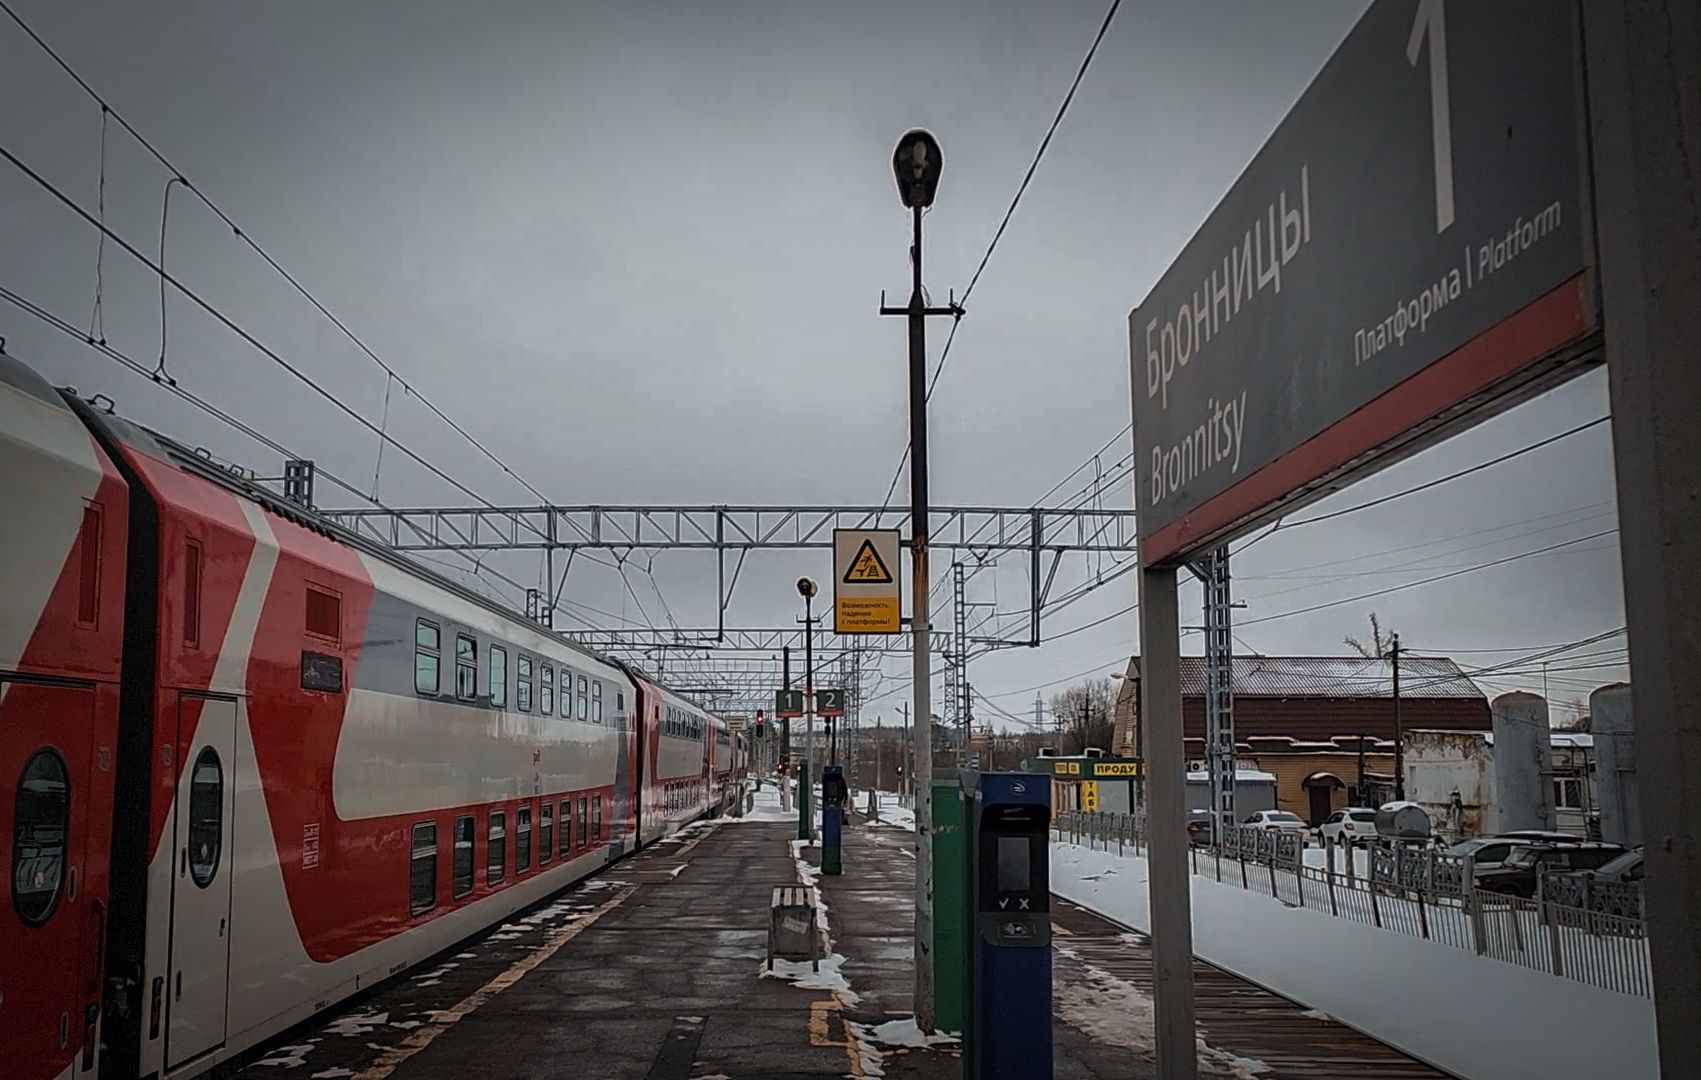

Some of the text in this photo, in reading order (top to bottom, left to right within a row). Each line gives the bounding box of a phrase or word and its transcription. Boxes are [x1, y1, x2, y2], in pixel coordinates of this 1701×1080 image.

[1404, 0, 1456, 235] 1
[1145, 164, 1312, 410] Бронницы
[1353, 199, 1562, 367] Платформа Platform
[1150, 390, 1248, 506] Bronnitsy
[785, 693, 792, 708] 1
[825, 692, 836, 708] 2
